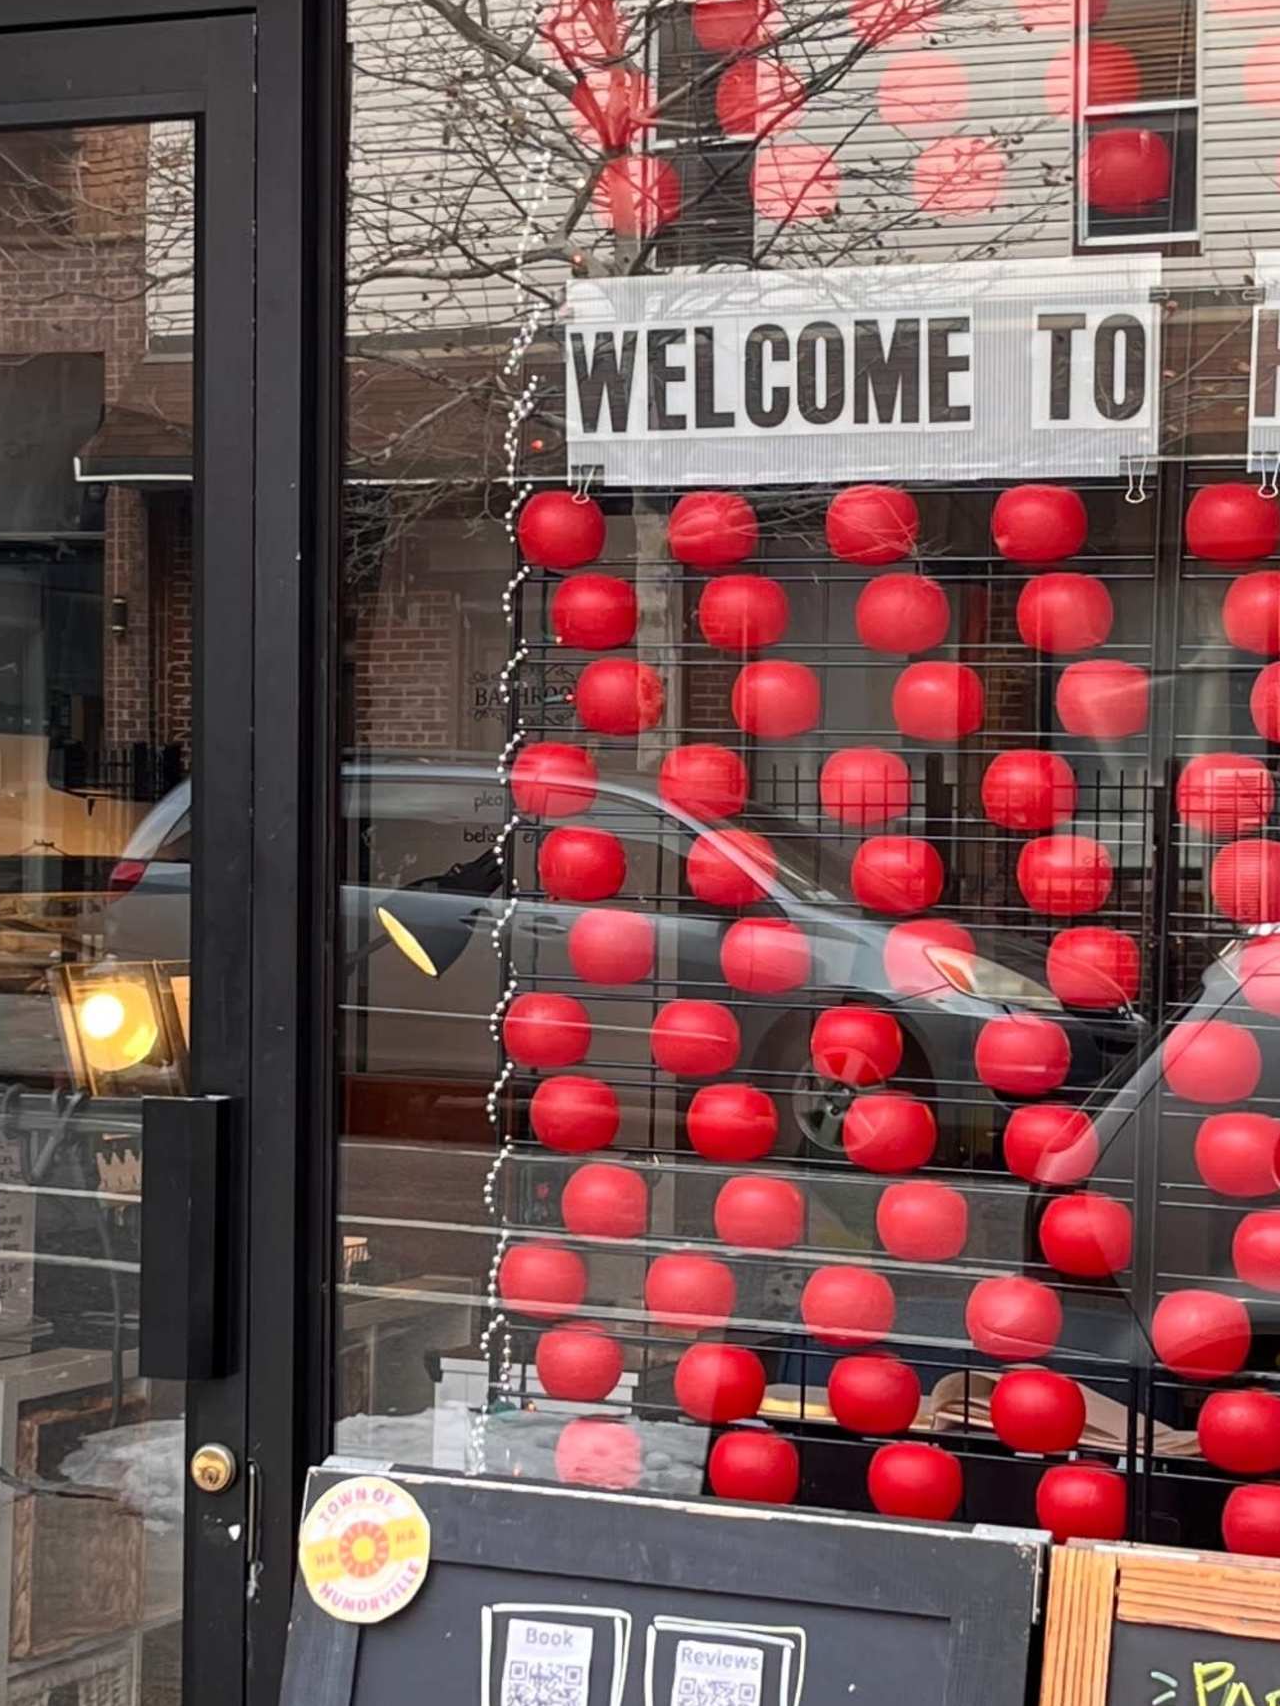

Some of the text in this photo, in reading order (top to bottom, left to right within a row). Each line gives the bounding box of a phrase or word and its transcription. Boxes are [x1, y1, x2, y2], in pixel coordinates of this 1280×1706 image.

[569, 317, 972, 434] WELCOME
[1036, 310, 1147, 423] TO
[319, 1488, 396, 1522] TOWN OF
[320, 1561, 420, 1612] HUMORVILLE
[526, 1627, 573, 1647] Book
[681, 1648, 759, 1670] Reviews
